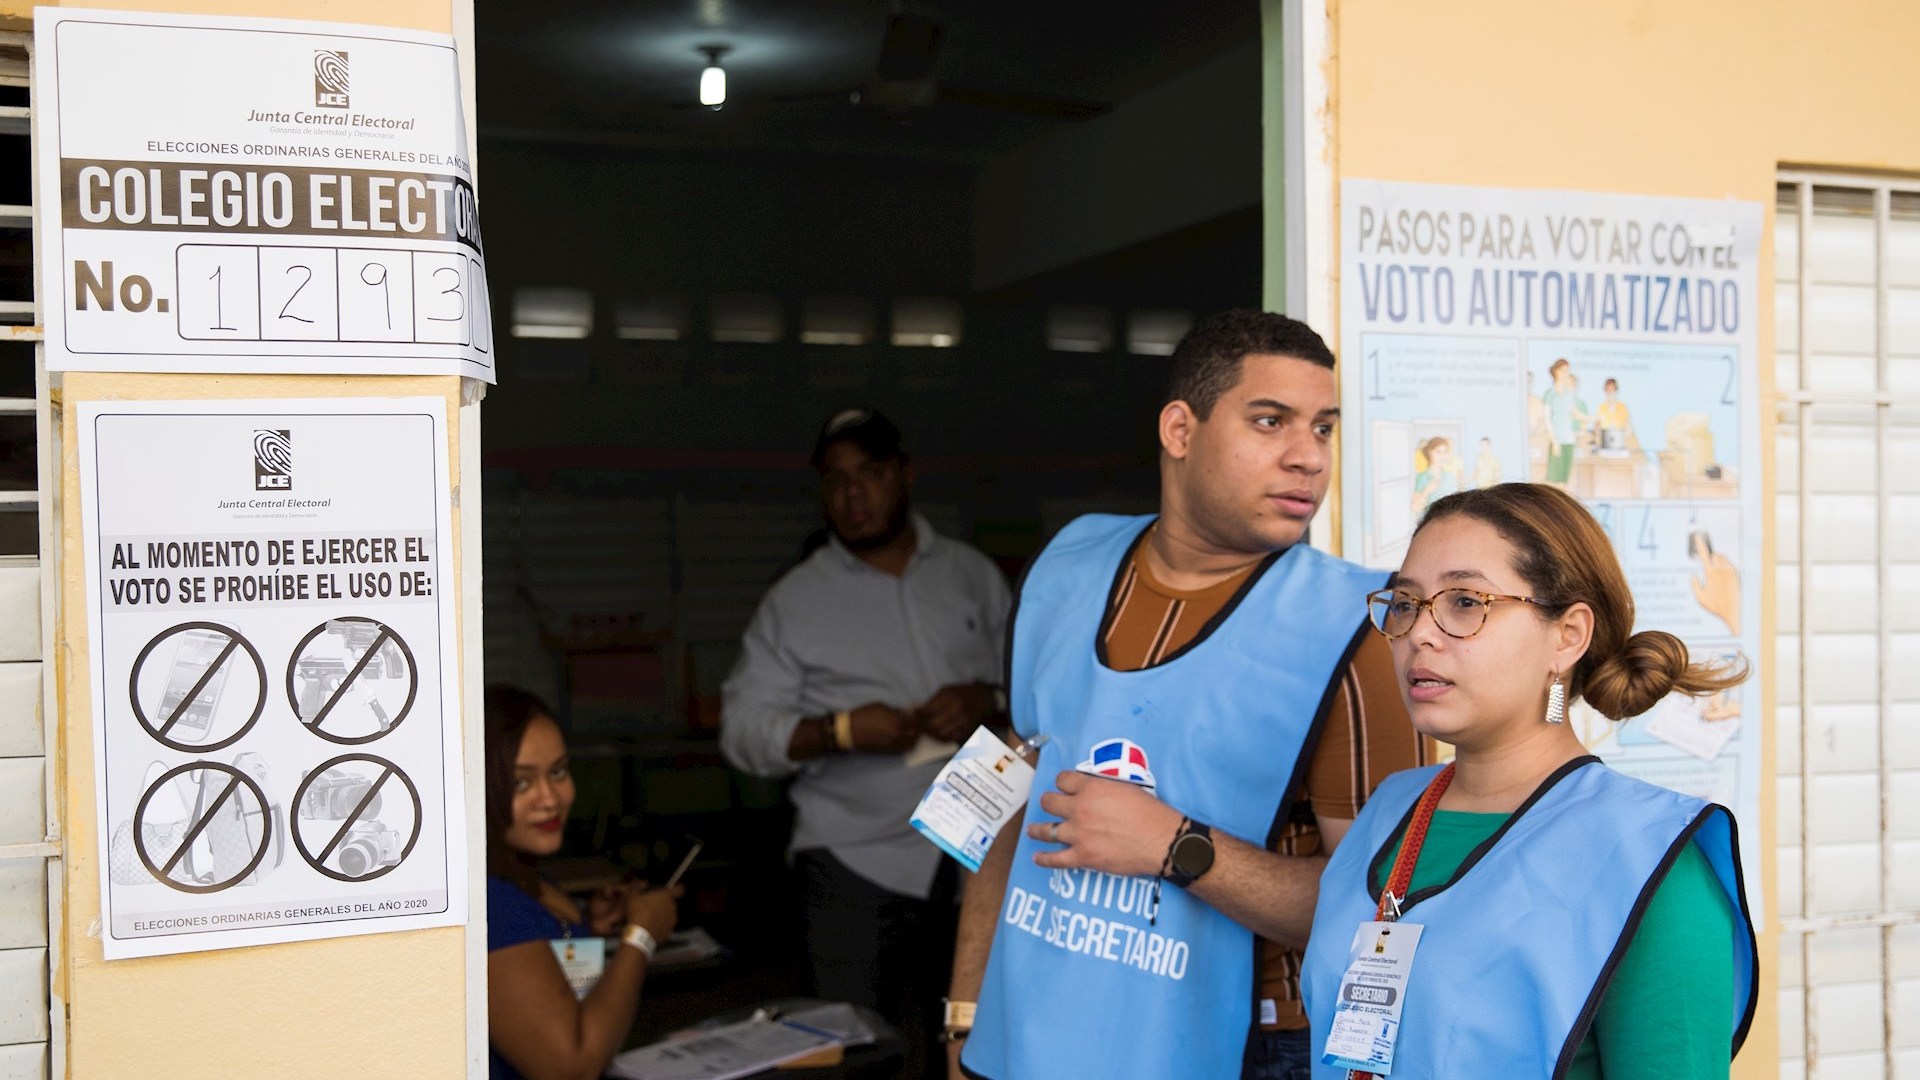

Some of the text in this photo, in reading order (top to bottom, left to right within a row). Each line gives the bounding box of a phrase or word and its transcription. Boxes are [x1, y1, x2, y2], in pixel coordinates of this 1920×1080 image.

[318, 92, 348, 106] JCE
[247, 109, 415, 131] Junta Central Electoral
[303, 127, 312, 136] de
[313, 127, 347, 137] Identidad
[354, 130, 395, 139] Democracia
[147, 141, 239, 155] ELECCIONES
[243, 144, 330, 159] ORDINARIAS
[334, 147, 416, 163] GENERALES
[420, 153, 443, 165] DEL
[78, 165, 294, 229] COLEGIO
[1358, 205, 1451, 257] PASOS
[1460, 212, 1537, 261] PARA
[1546, 216, 1643, 265] VOTAR
[74, 260, 170, 313] No.
[1359, 262, 1741, 335] VOTO AUTOMATIZADO
[1368, 348, 1386, 401] 1
[1720, 354, 1737, 405] 2
[258, 474, 290, 488] JCE
[218, 498, 331, 509] Junta Central Electoral
[1637, 504, 1660, 561] 4
[112, 537, 429, 570] AL MOMENTO DE EJERCER EL
[110, 568, 433, 605] VOTO SE PROHÍBE EL USO DE:
[134, 899, 428, 932] ELECCIONES ORDINARIAS GENERALES DEL AÑO 2020
[1005, 887, 1190, 981] DEL SECRETARIO
[1350, 985, 1388, 1003] SECRETARIO
[1365, 1007, 1393, 1016] ELECTORAL
